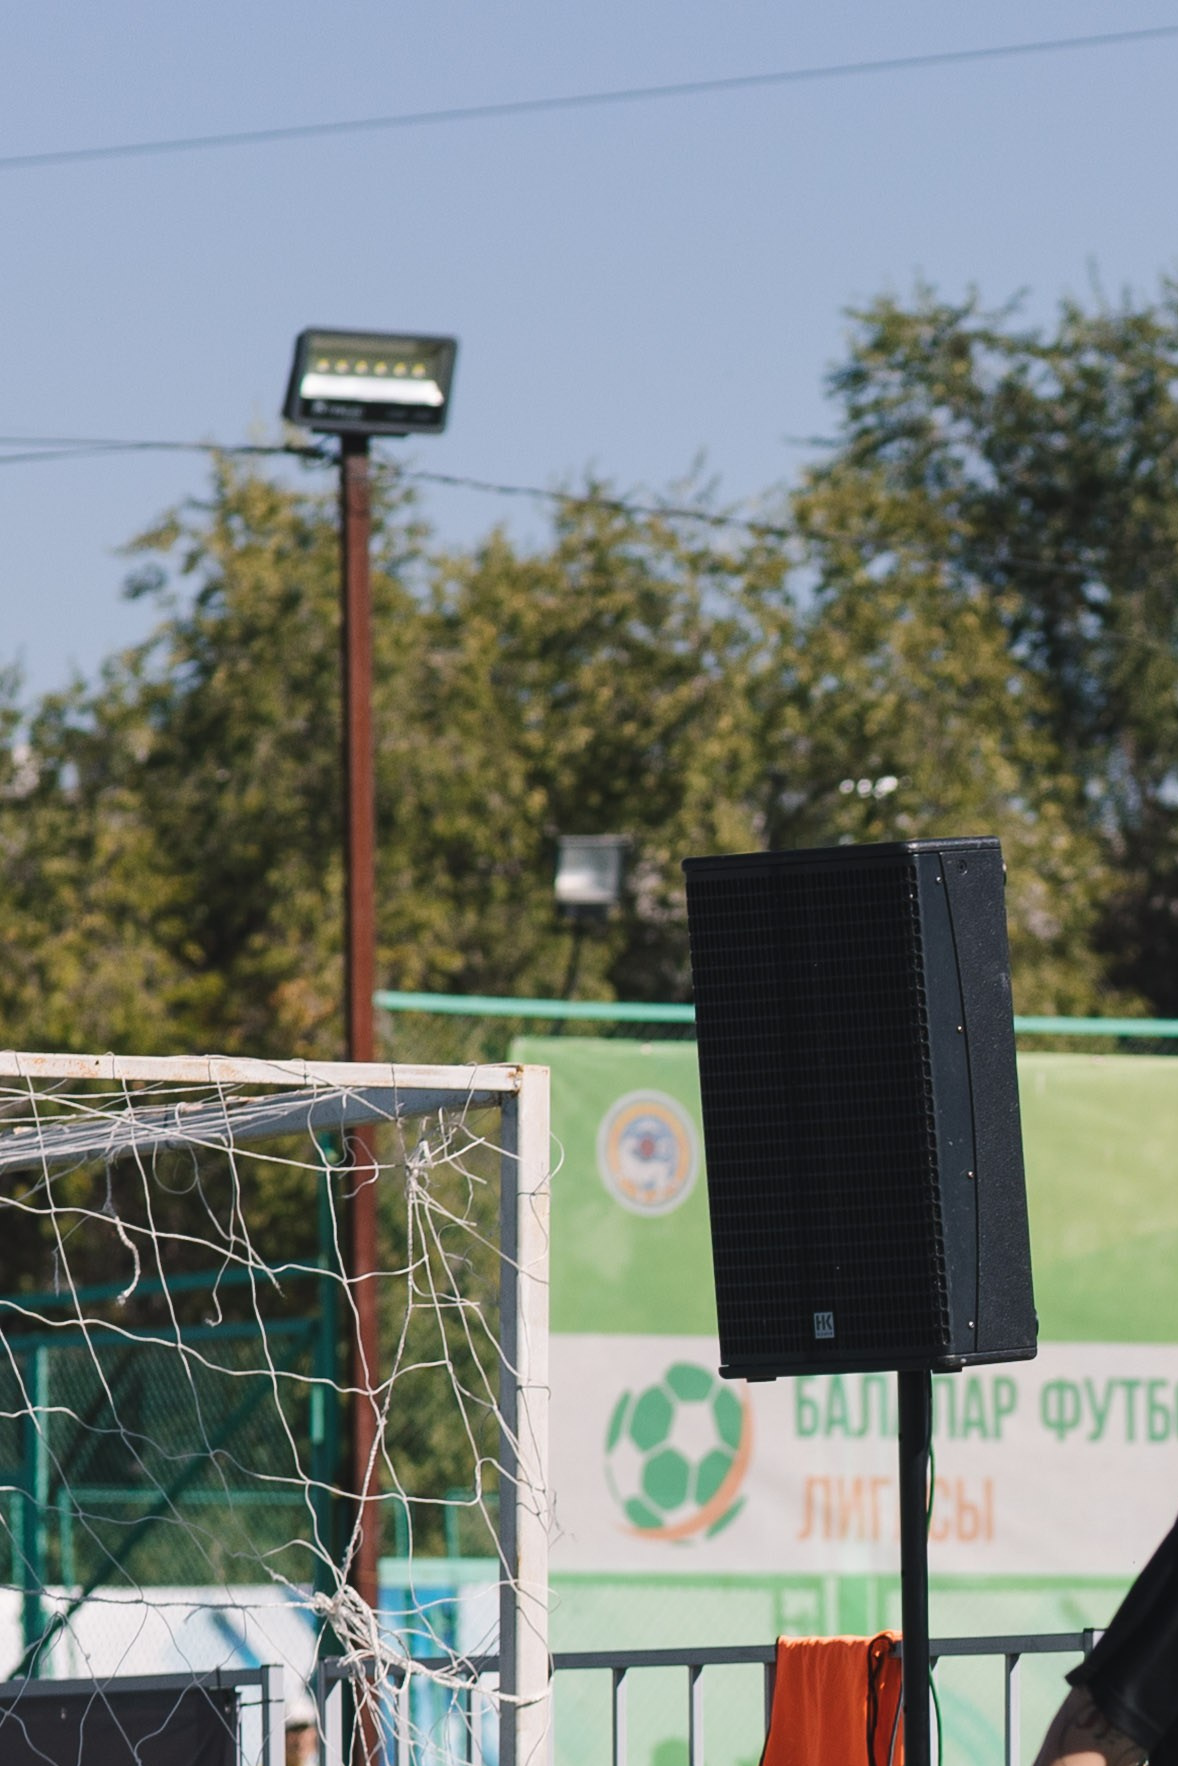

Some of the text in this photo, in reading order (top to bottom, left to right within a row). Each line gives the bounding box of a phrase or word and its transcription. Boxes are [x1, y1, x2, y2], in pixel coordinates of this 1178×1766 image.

[815, 1314, 832, 1331] HK
[794, 1376, 1018, 1441] БАЛЛАР
[797, 1475, 995, 1544] ЛИГСЫ
